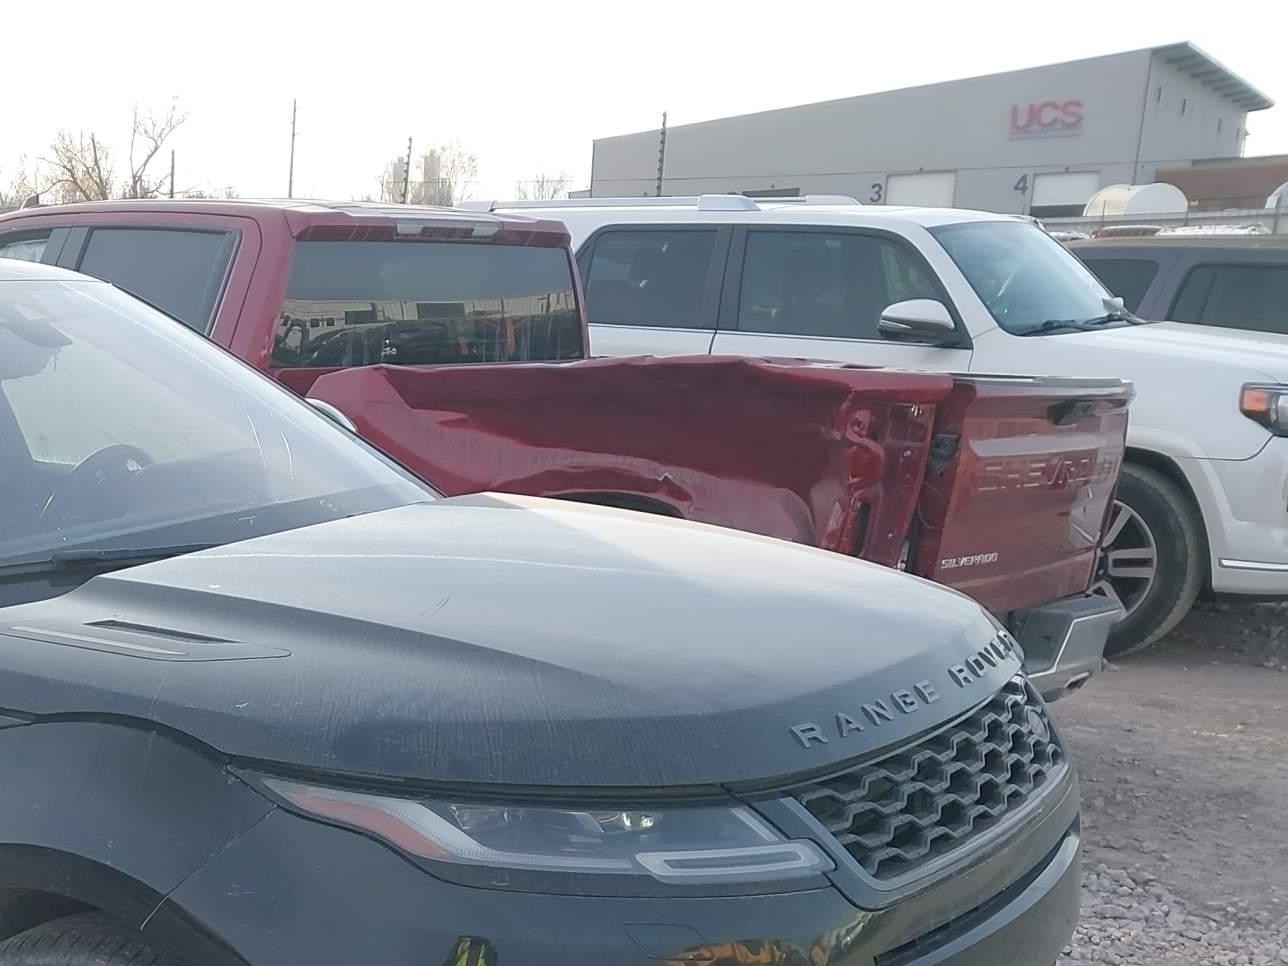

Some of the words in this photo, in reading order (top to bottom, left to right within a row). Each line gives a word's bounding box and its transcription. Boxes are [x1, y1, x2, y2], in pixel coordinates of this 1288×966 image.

[1010, 100, 1083, 132] UCS
[870, 183, 883, 202] 3
[1014, 174, 1029, 195] 4
[940, 552, 999, 569] SILVERADO
[789, 679, 941, 749] RANGE
